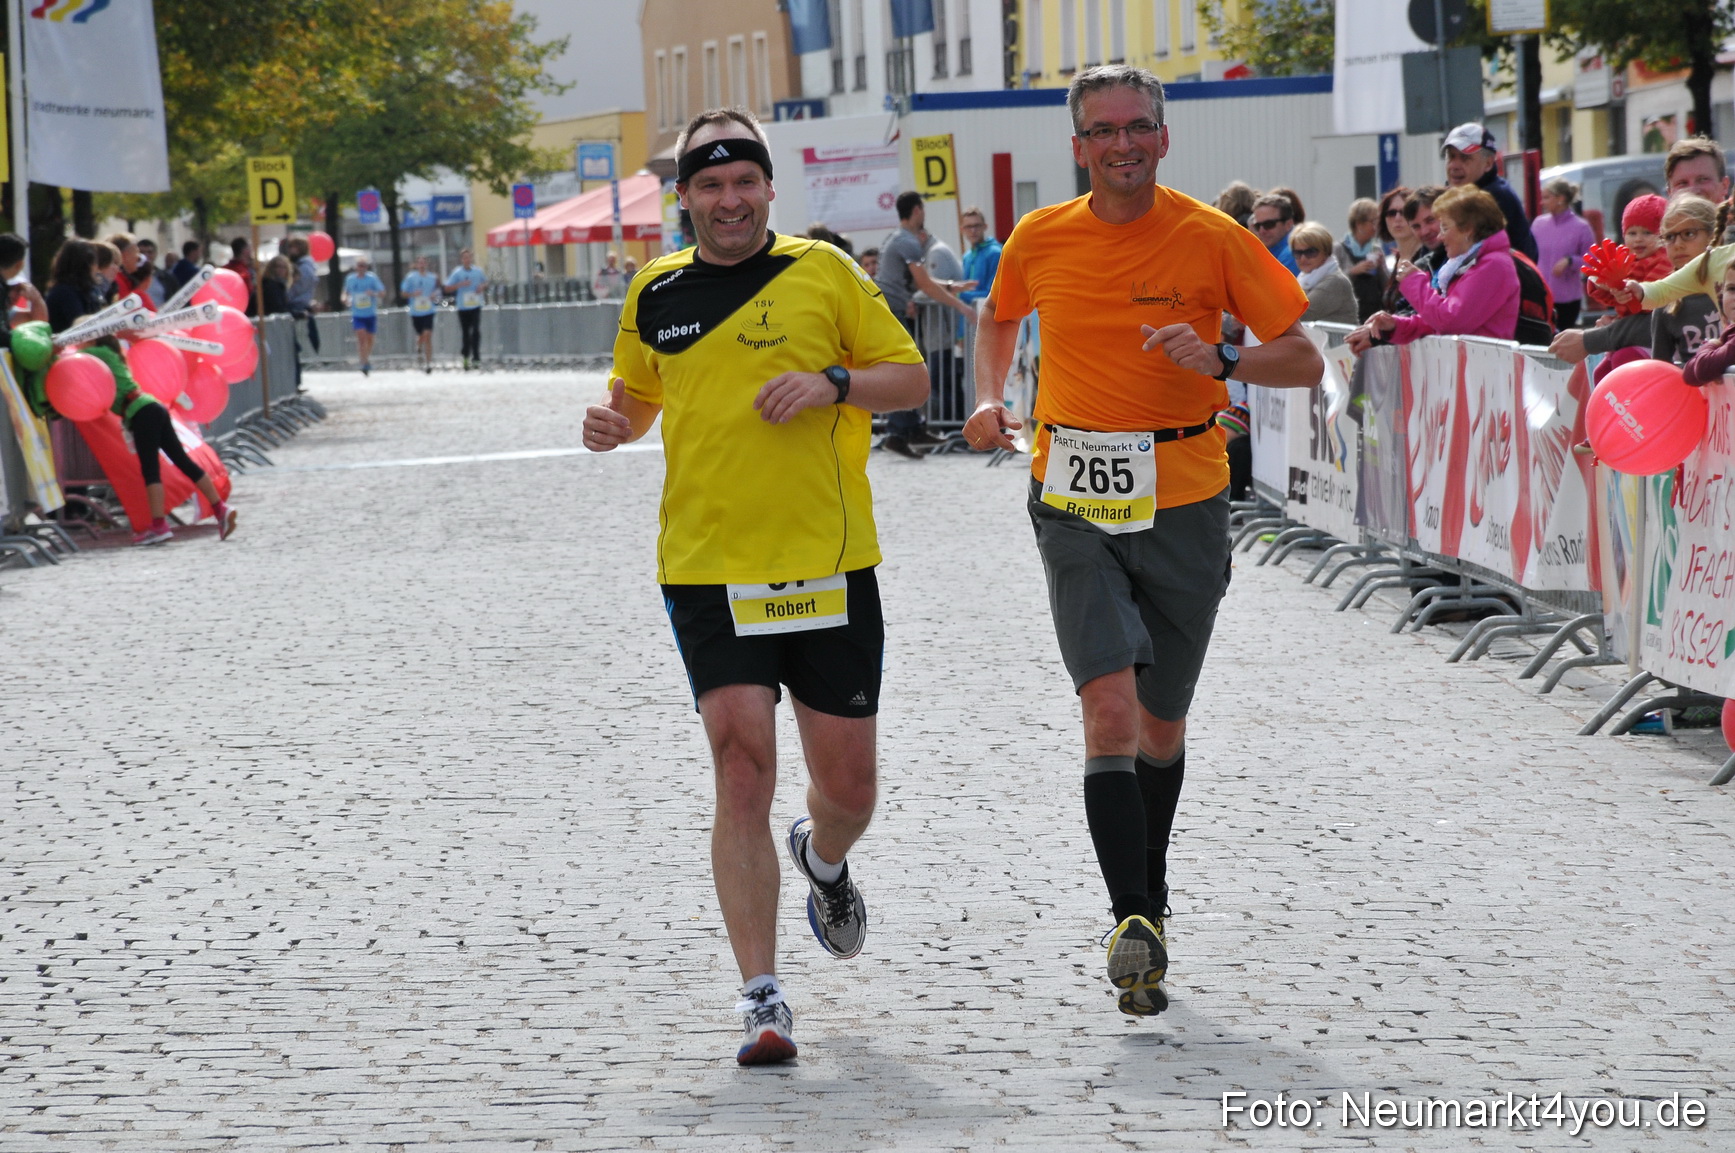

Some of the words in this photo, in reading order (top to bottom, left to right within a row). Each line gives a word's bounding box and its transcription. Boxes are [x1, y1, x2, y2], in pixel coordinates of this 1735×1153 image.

[94, 107, 154, 119] neumarkt
[916, 137, 951, 151] Block
[253, 160, 287, 173] Block
[924, 156, 947, 187] D
[261, 178, 284, 209] D
[753, 300, 775, 308] TSV
[657, 321, 701, 344] Robert
[736, 332, 788, 350] Burgthann
[1054, 435, 1079, 450] PARTL
[1081, 441, 1133, 452] Neumarkt
[1069, 454, 1134, 495] 265
[1066, 501, 1131, 520] Reinhard
[765, 598, 817, 618] Robert
